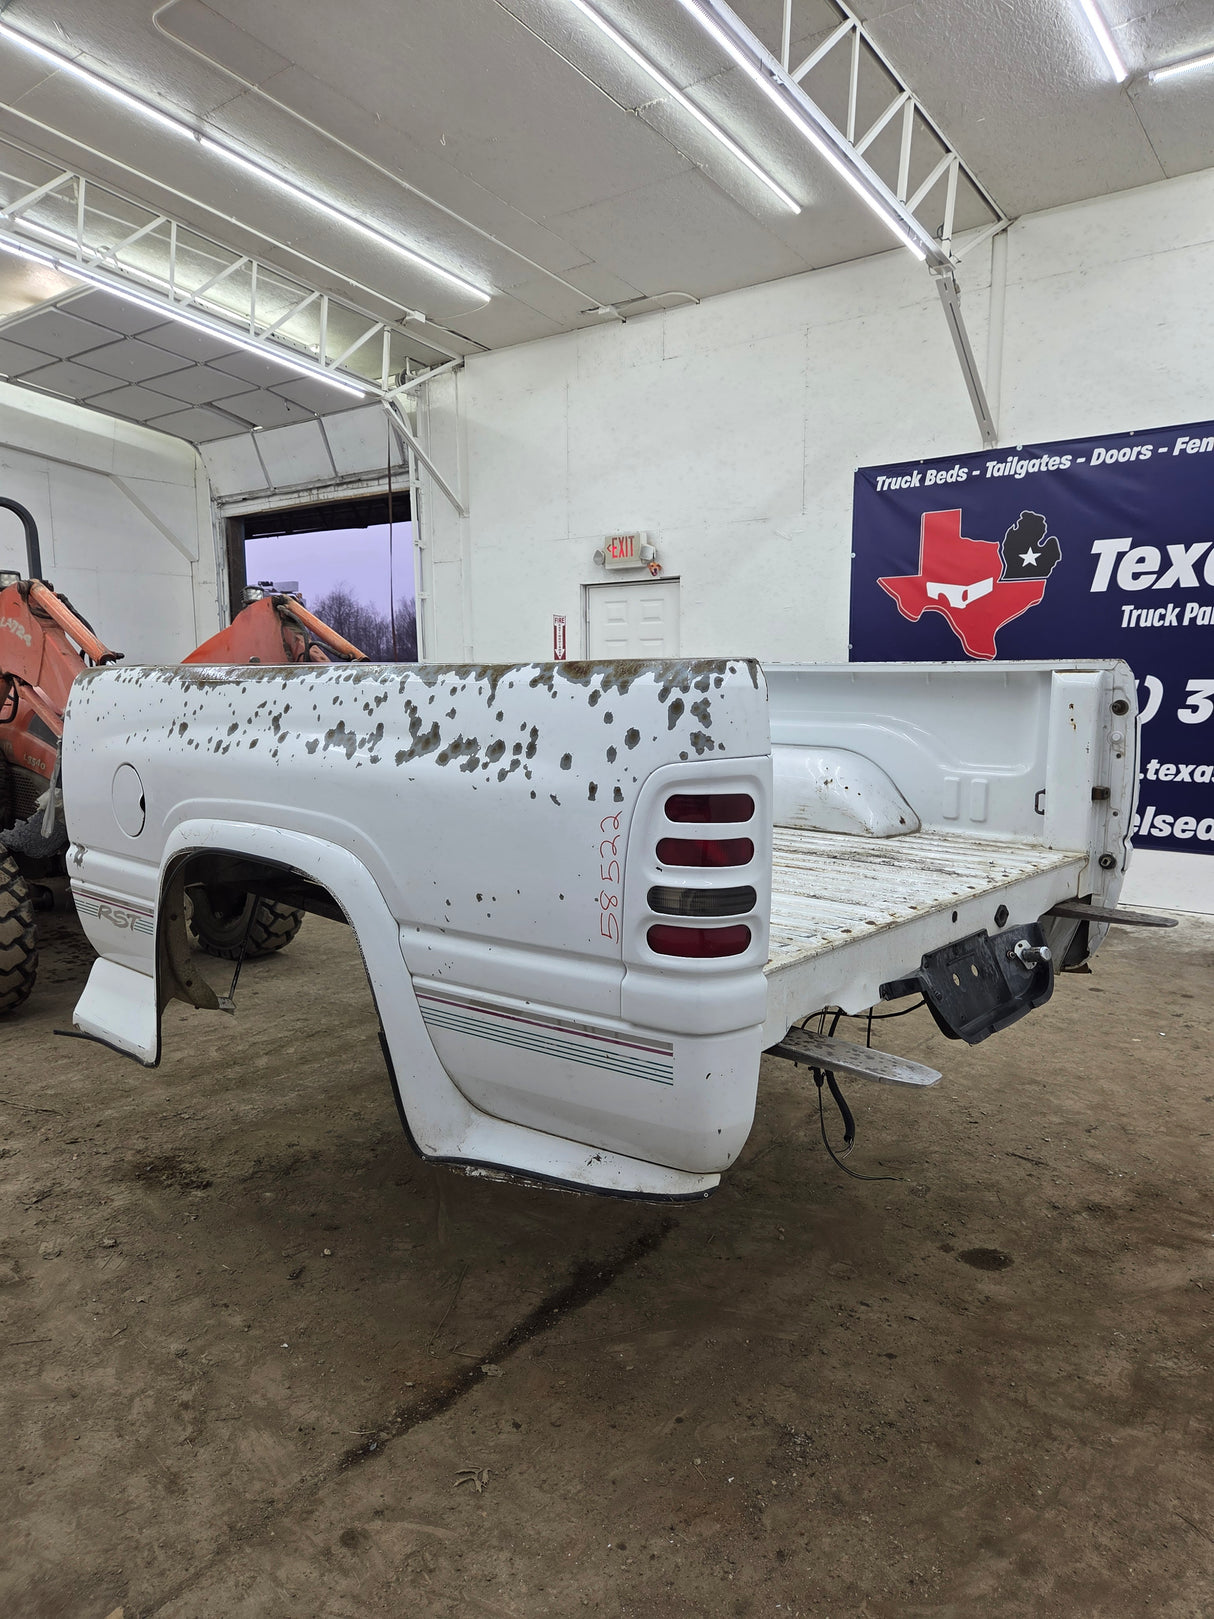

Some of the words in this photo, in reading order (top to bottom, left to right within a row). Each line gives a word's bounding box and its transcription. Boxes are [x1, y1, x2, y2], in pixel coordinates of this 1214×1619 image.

[876, 469, 923, 493] Truck
[924, 464, 969, 486] Beds
[985, 454, 1073, 479] Tailgates
[1089, 446, 1154, 467] Doors
[611, 535, 635, 559] EXIT
[1090, 537, 1214, 593] Tex
[1121, 603, 1181, 628] Truck
[600, 810, 623, 945] 58522
[97, 904, 142, 931] RST
